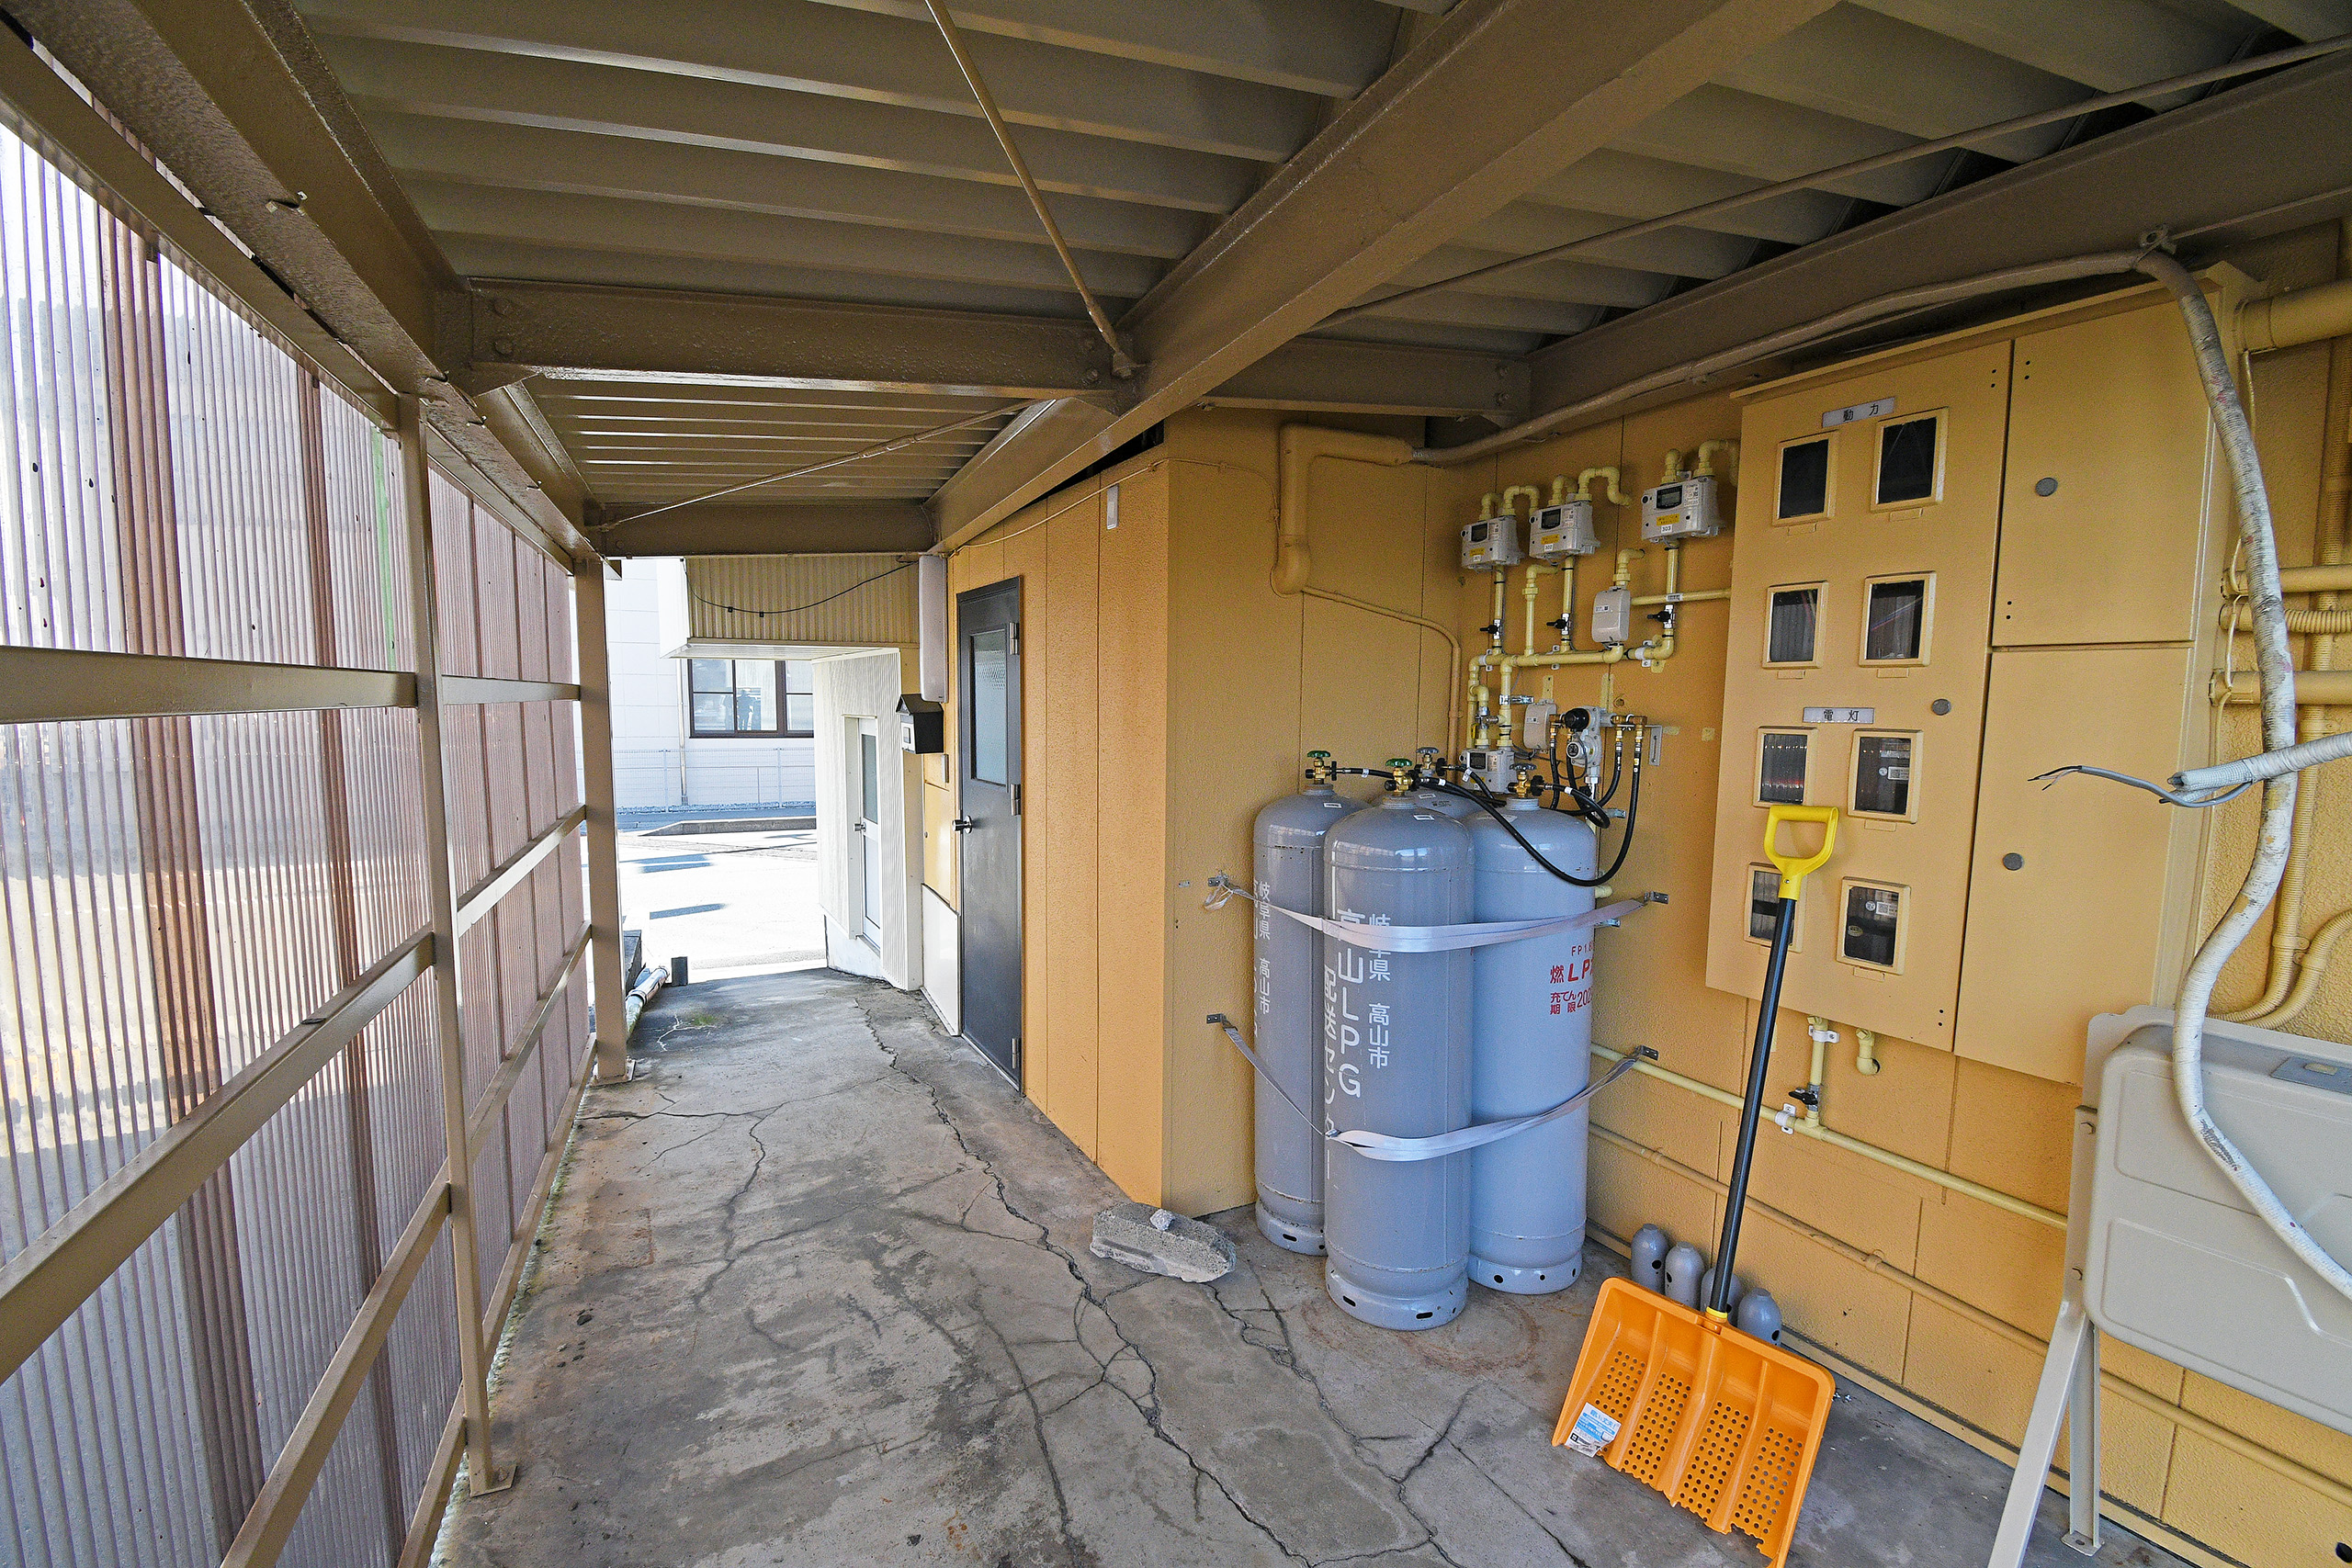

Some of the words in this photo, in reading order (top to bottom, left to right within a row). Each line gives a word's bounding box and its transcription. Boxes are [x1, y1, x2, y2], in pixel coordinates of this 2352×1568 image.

[1843, 403, 1879, 422] 動力
[1824, 709, 1860, 722] 電灯
[1368, 913, 1392, 981] 岐県
[1368, 1002, 1391, 1069] 高山市
